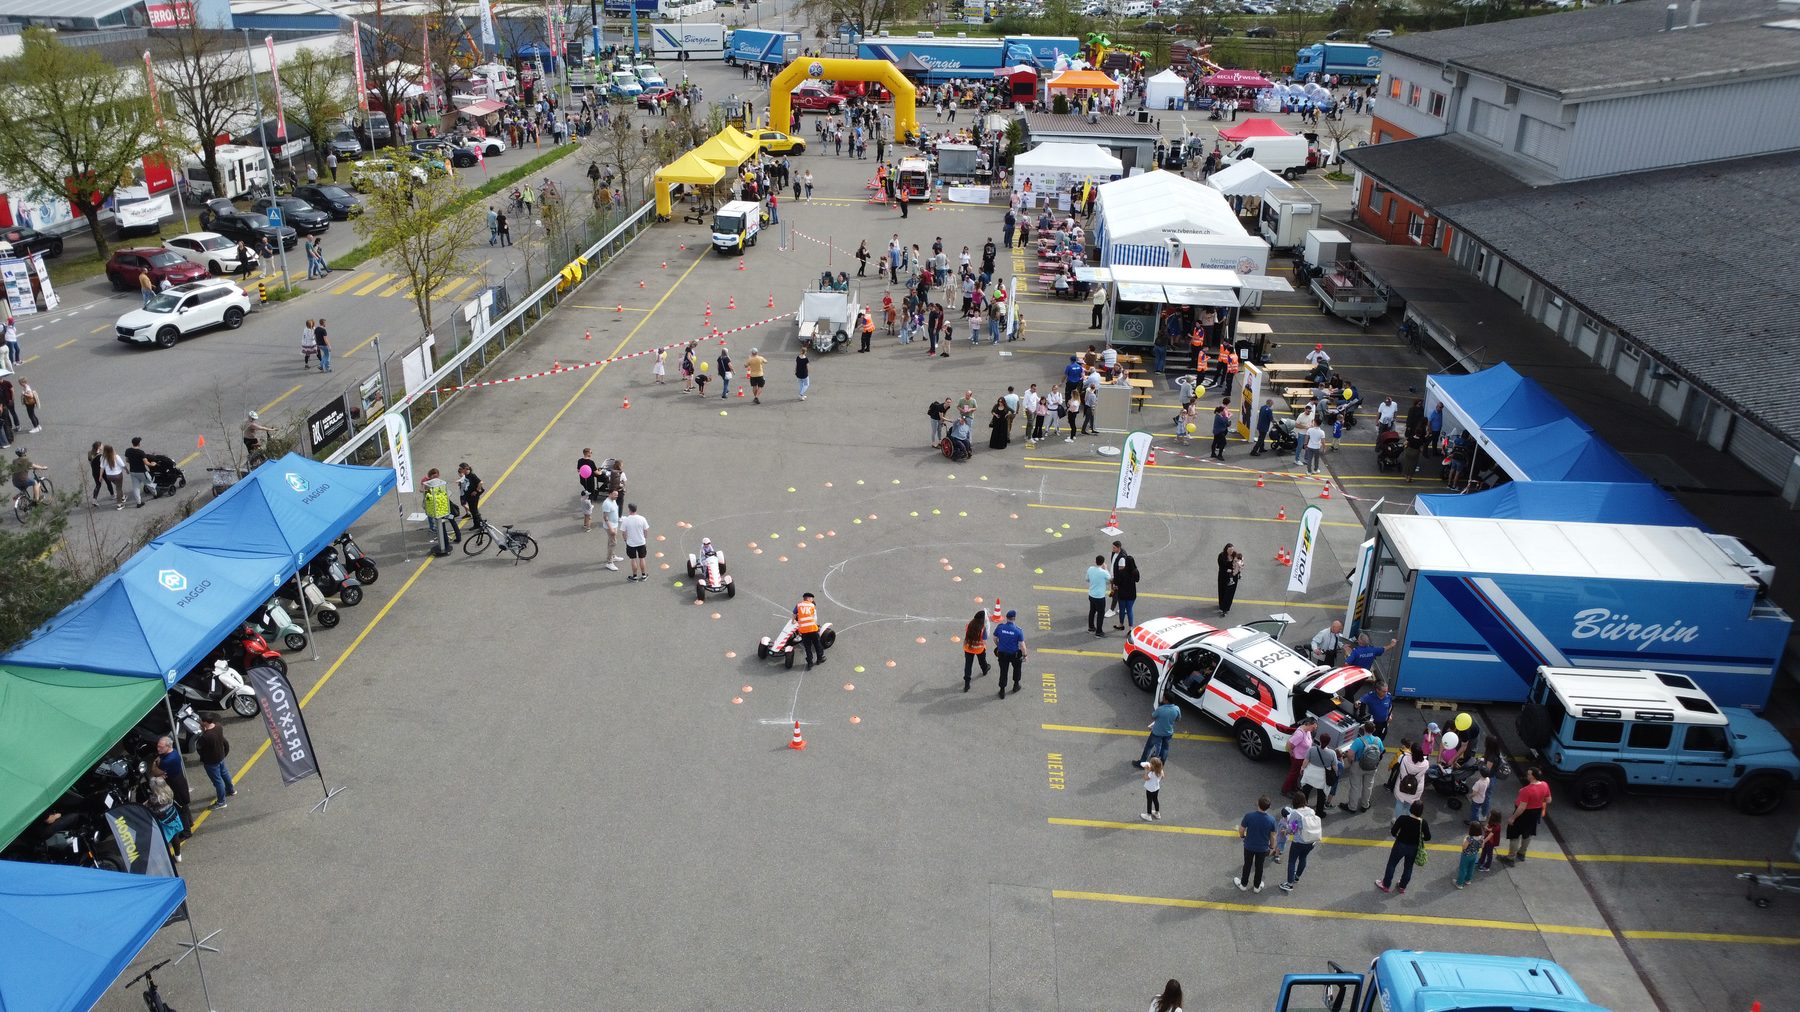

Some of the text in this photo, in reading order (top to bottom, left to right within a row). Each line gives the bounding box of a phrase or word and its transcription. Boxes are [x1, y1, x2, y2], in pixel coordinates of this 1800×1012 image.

[302, 483, 330, 504] PIAGGIO
[1298, 526, 1312, 585] POLIZEI
[177, 579, 212, 608] PIAGGIO
[1037, 605, 1051, 630] MIETER
[1572, 607, 1699, 652] Bürgin
[1253, 649, 1292, 668] 2525
[1042, 673, 1057, 704] MIETER
[1048, 753, 1065, 790] MIETER
